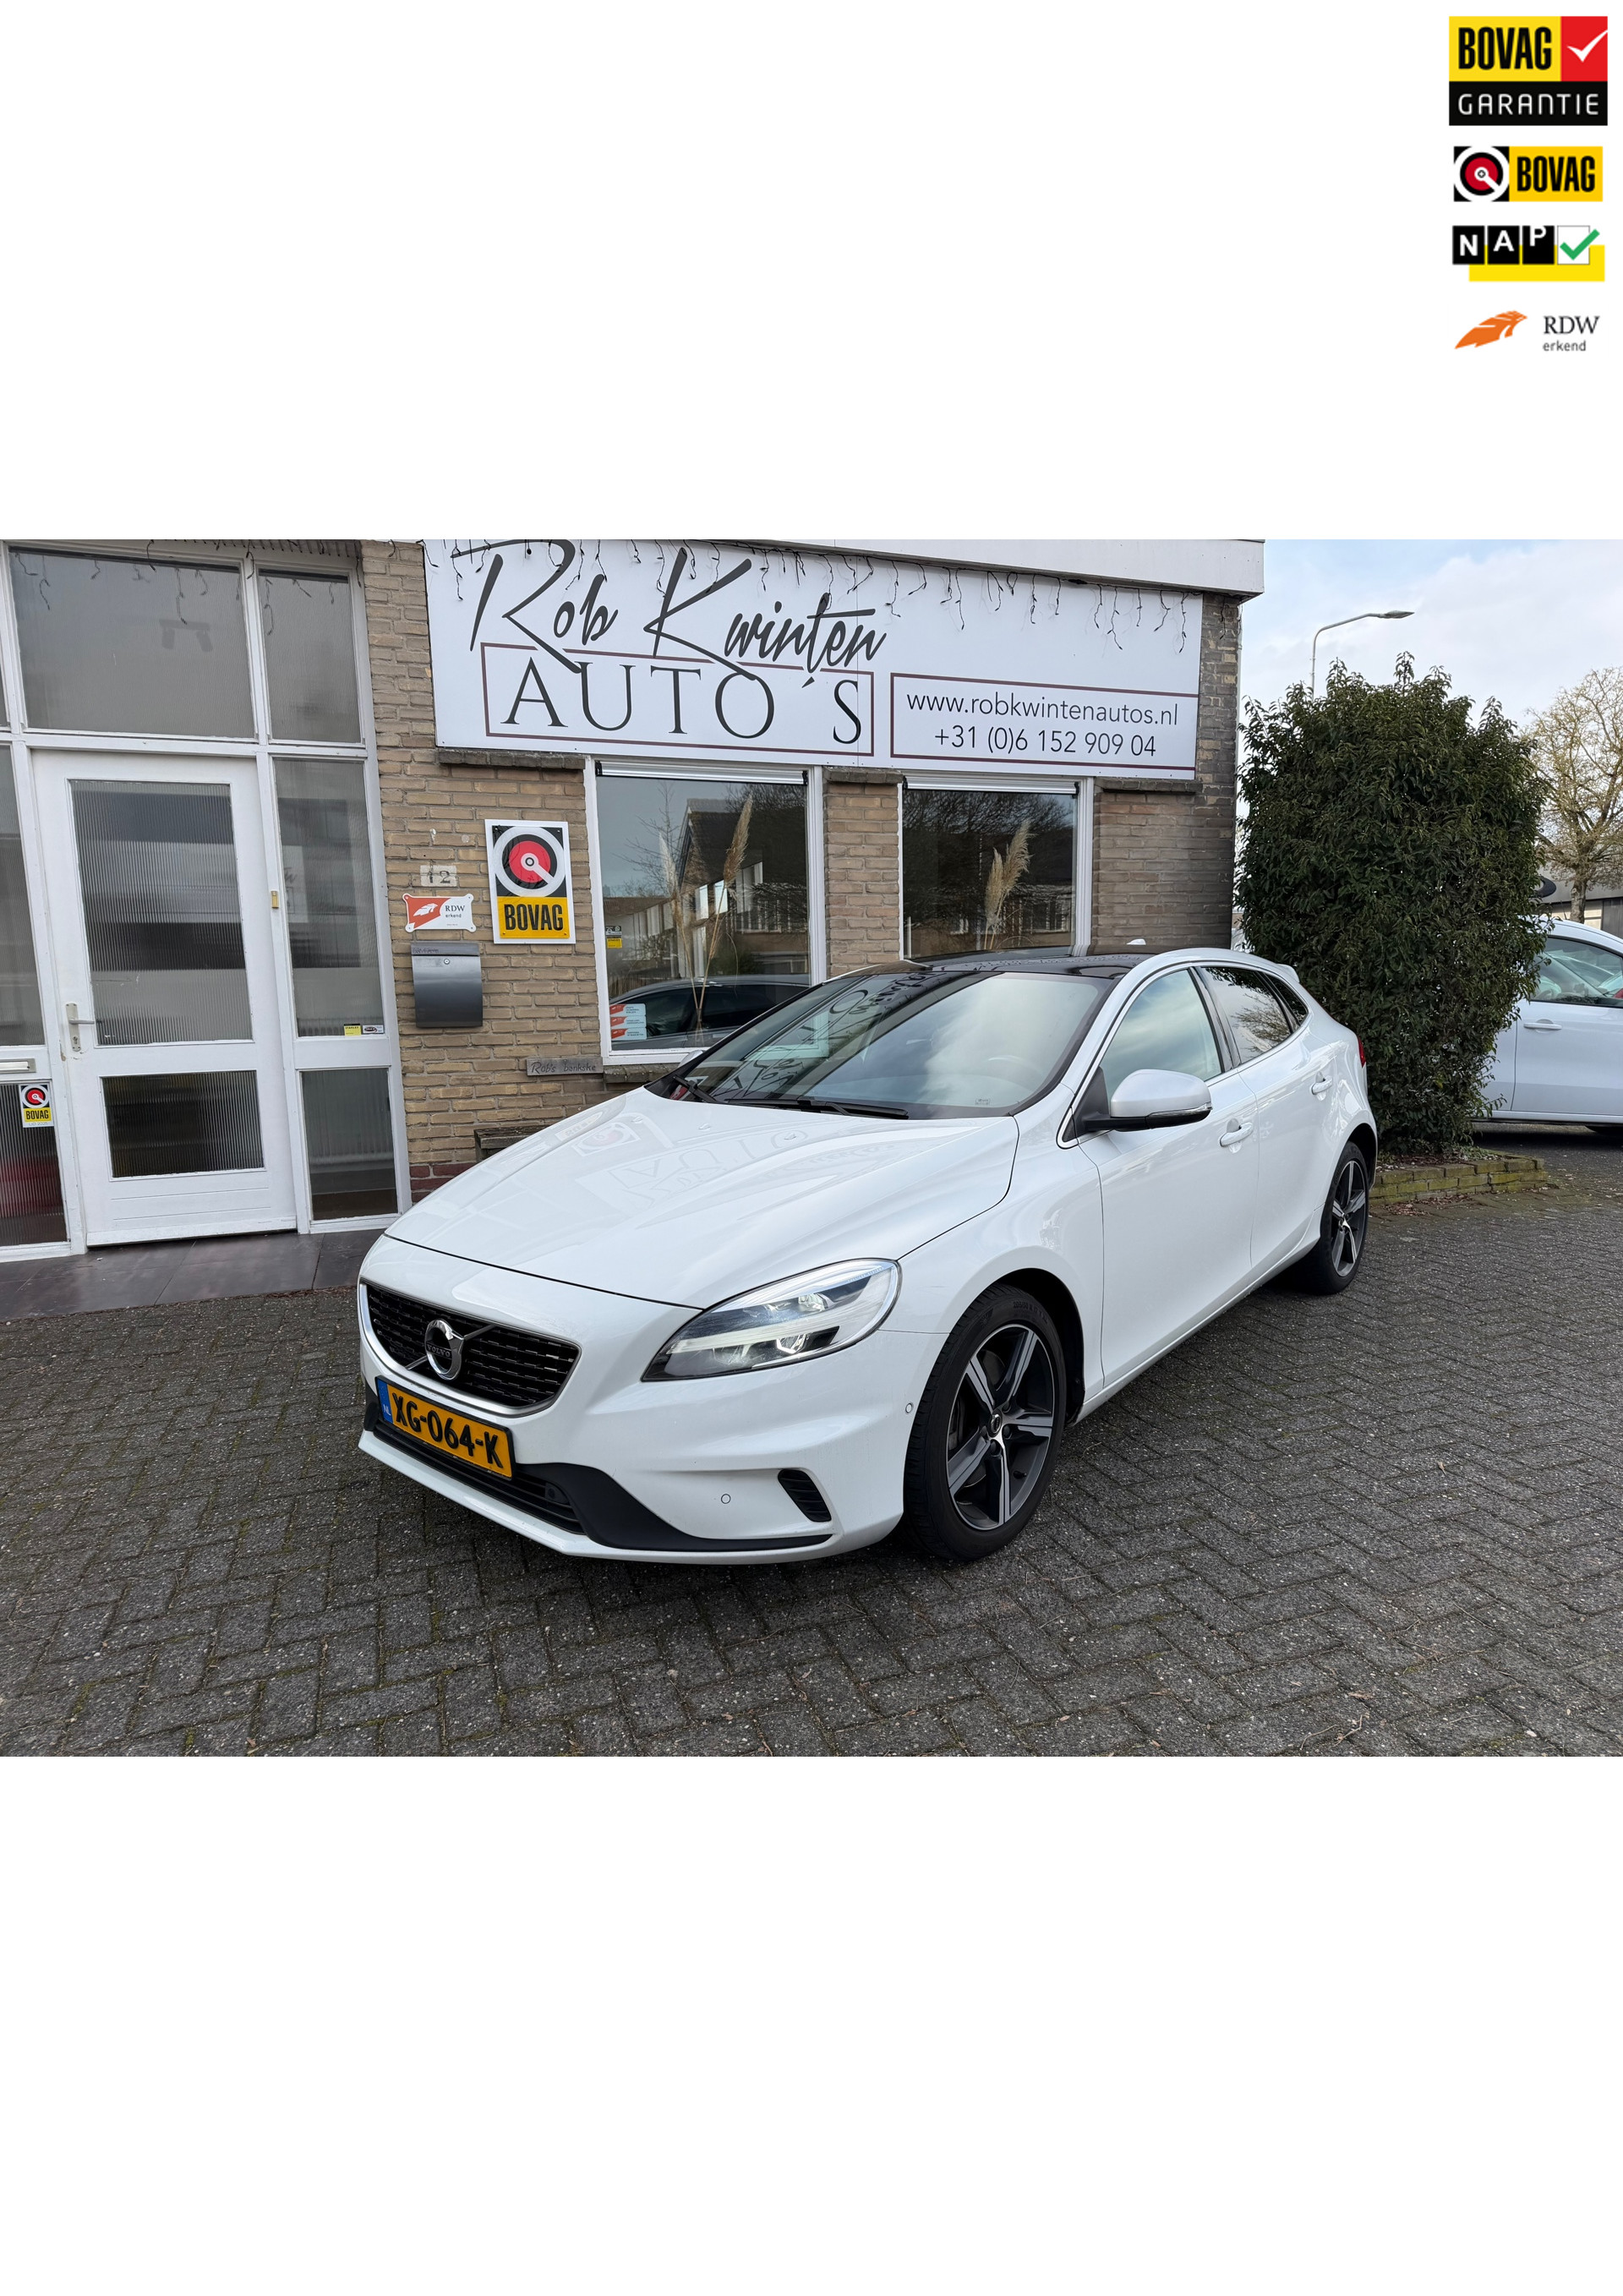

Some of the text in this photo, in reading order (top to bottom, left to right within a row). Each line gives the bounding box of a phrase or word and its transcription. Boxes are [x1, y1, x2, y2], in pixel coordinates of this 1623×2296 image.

[451, 539, 887, 681] Rob Kwinten
[906, 692, 1178, 725] www.robkwintenautos.nl
[934, 724, 1156, 757] +31 (0)6 152 909 04
[427, 870, 451, 884] 12
[504, 903, 564, 931] BOVAG
[531, 1061, 556, 1074] Rob's
[25, 1109, 49, 1120] BOVAG
[427, 1344, 451, 1357] VOLVO
[383, 1404, 391, 1416] NL
[392, 1392, 504, 1468] XG-064-K
